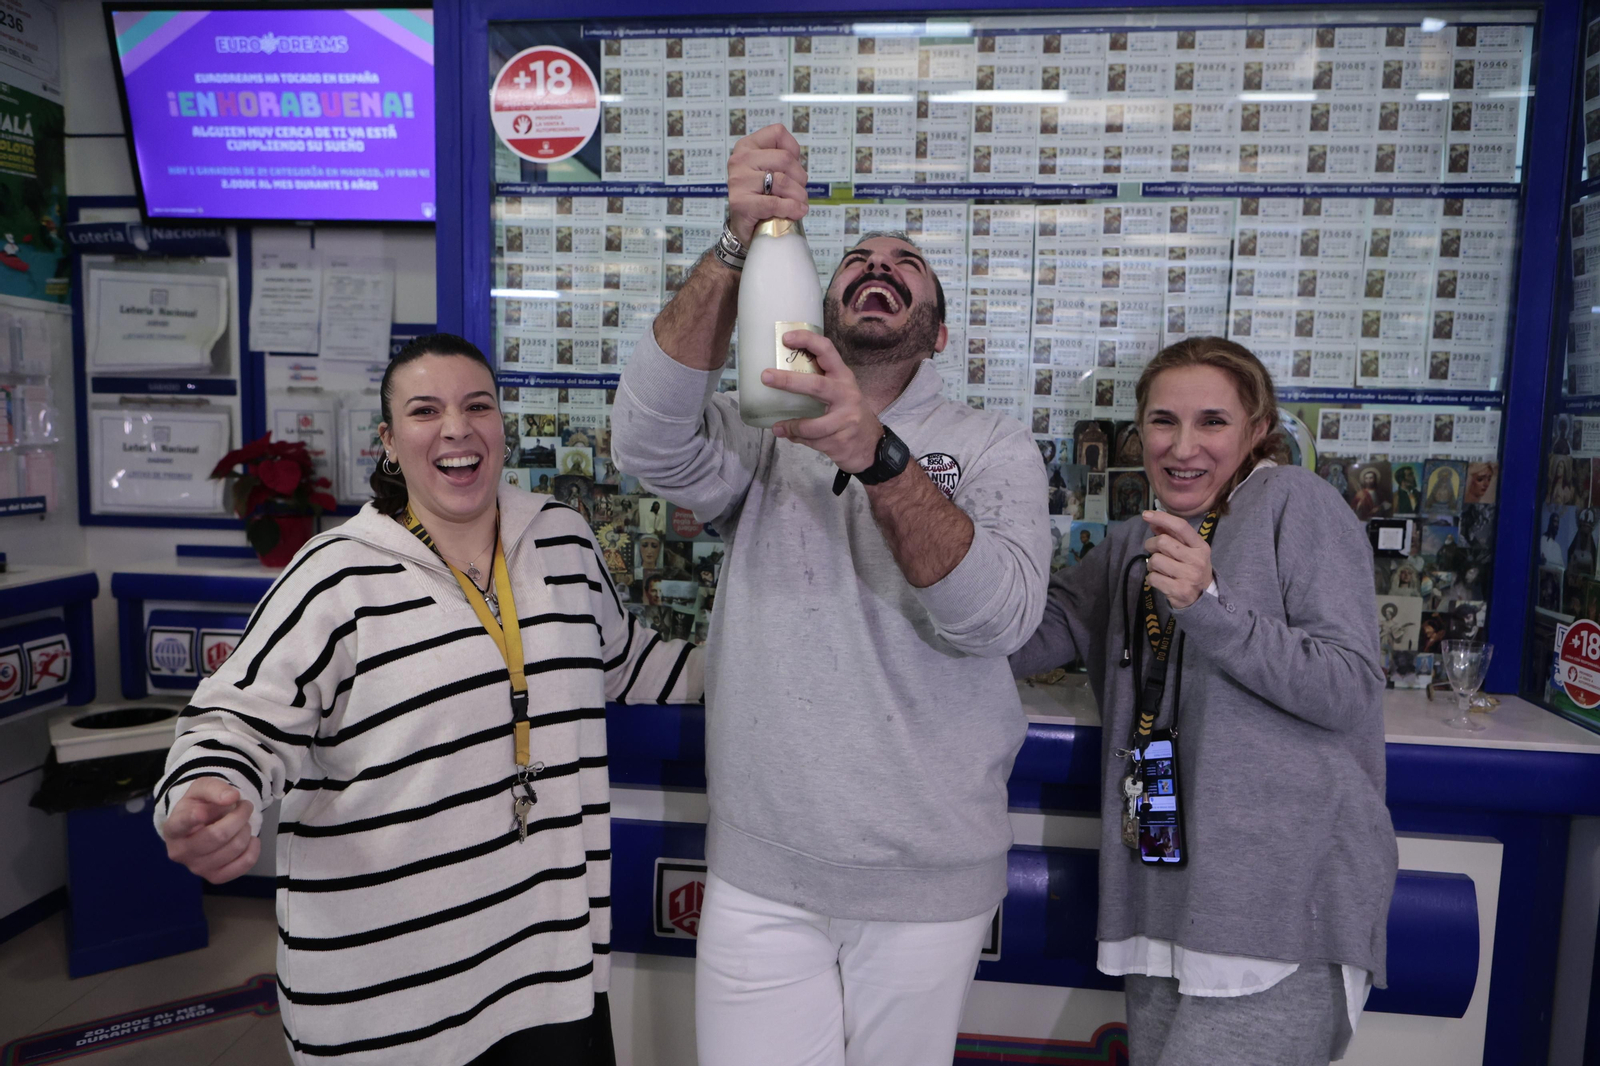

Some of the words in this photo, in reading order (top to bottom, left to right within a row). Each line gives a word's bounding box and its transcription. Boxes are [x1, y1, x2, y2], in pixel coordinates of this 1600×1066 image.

[1477, 61, 1508, 69] 16946
[194, 72, 263, 84] EURODREAMS
[264, 72, 280, 84] HA
[280, 72, 321, 84] TOCADO
[322, 72, 337, 84] EN
[338, 70, 380, 84] ESPAÑA
[513, 59, 573, 96] +18
[166, 91, 415, 118] ¡ENHORABUENA!
[192, 125, 246, 138] ALGUIEN
[247, 126, 274, 138] MUY
[275, 126, 314, 138] CERCA
[314, 126, 332, 138] DE
[332, 126, 347, 139] TI
[365, 123, 397, 139] ESTÁ
[226, 139, 305, 152] CUMPLIENDO
[306, 140, 323, 152] SU
[324, 137, 365, 152] SUEÑO
[269, 165, 324, 177] CATEGORÍA
[258, 179, 272, 190] AL
[273, 179, 294, 190] MES
[294, 180, 342, 190] DURANTE
[350, 178, 379, 190] AÑOS
[887, 188, 892, 196] y
[901, 187, 938, 196] Apuestas
[940, 187, 952, 195] del
[953, 187, 980, 195] Estado
[1032, 187, 1068, 196] Apuestas
[1070, 187, 1083, 195] del
[1084, 187, 1112, 195] Estado
[1145, 594, 1153, 610] STOP
[1160, 636, 1170, 650] NOT
[1571, 630, 1600, 660] +18
[1156, 651, 1166, 662] DO
[76, 1023, 150, 1046] DURANTE
[153, 1018, 173, 1027] 30
[175, 1007, 215, 1022] AÑOS
[84, 1016, 151, 1038] 20.000€
[153, 1012, 174, 1020] AL
[176, 1003, 206, 1015] MES
